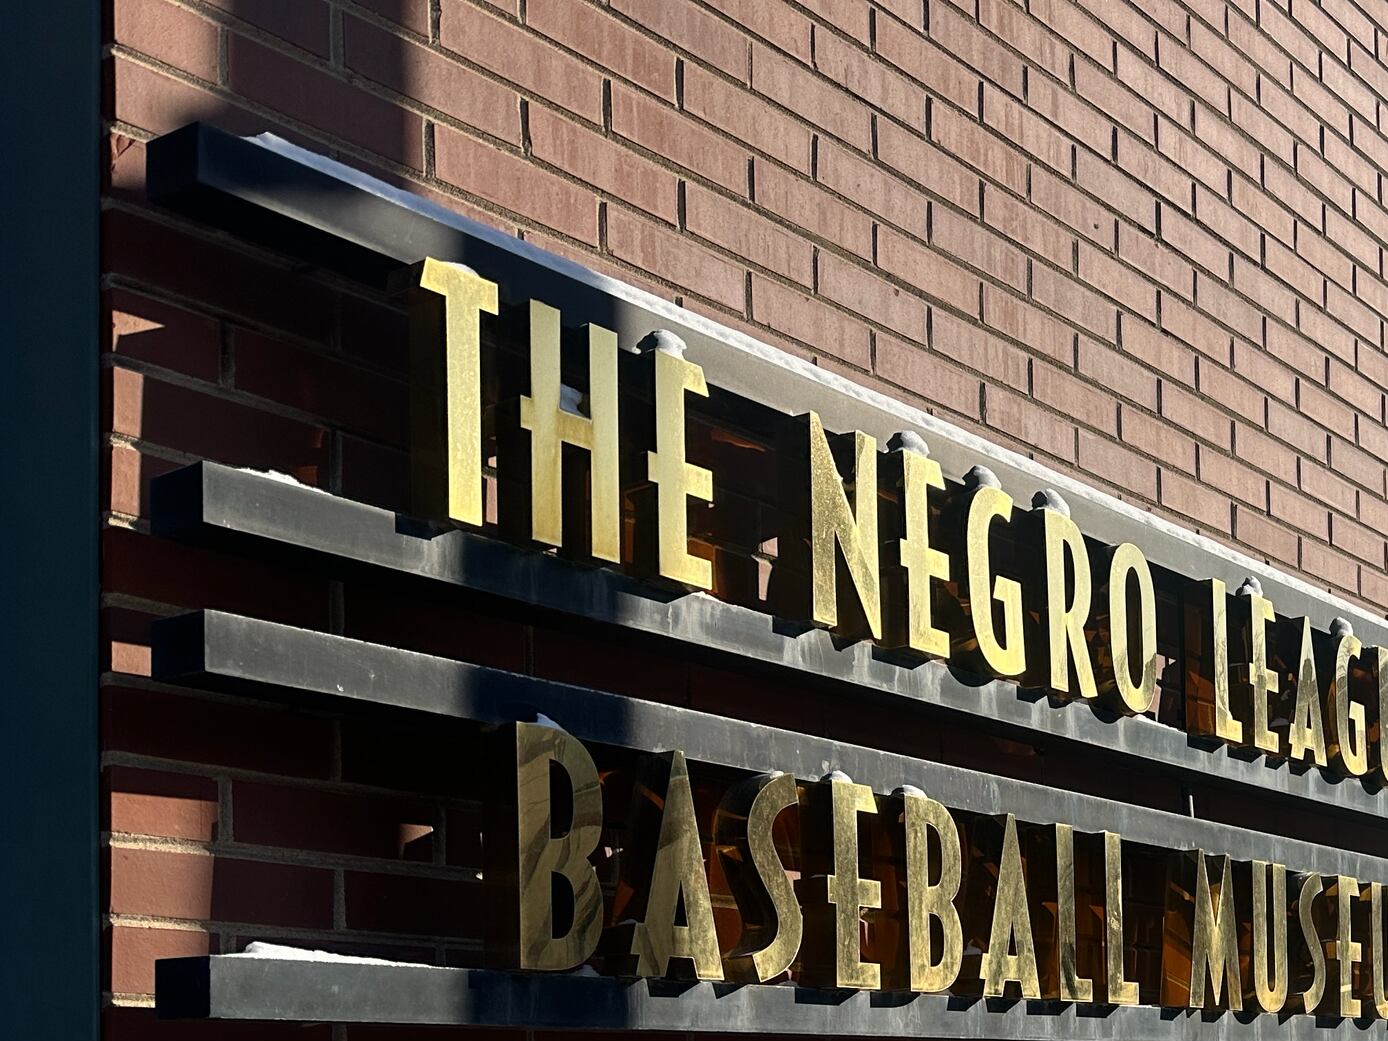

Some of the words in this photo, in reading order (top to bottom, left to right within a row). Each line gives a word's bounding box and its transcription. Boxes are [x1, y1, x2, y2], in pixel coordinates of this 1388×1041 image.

[420, 256, 713, 591] THE
[809, 410, 1158, 714] NEGRO
[516, 720, 1140, 1006] BASEBALL
